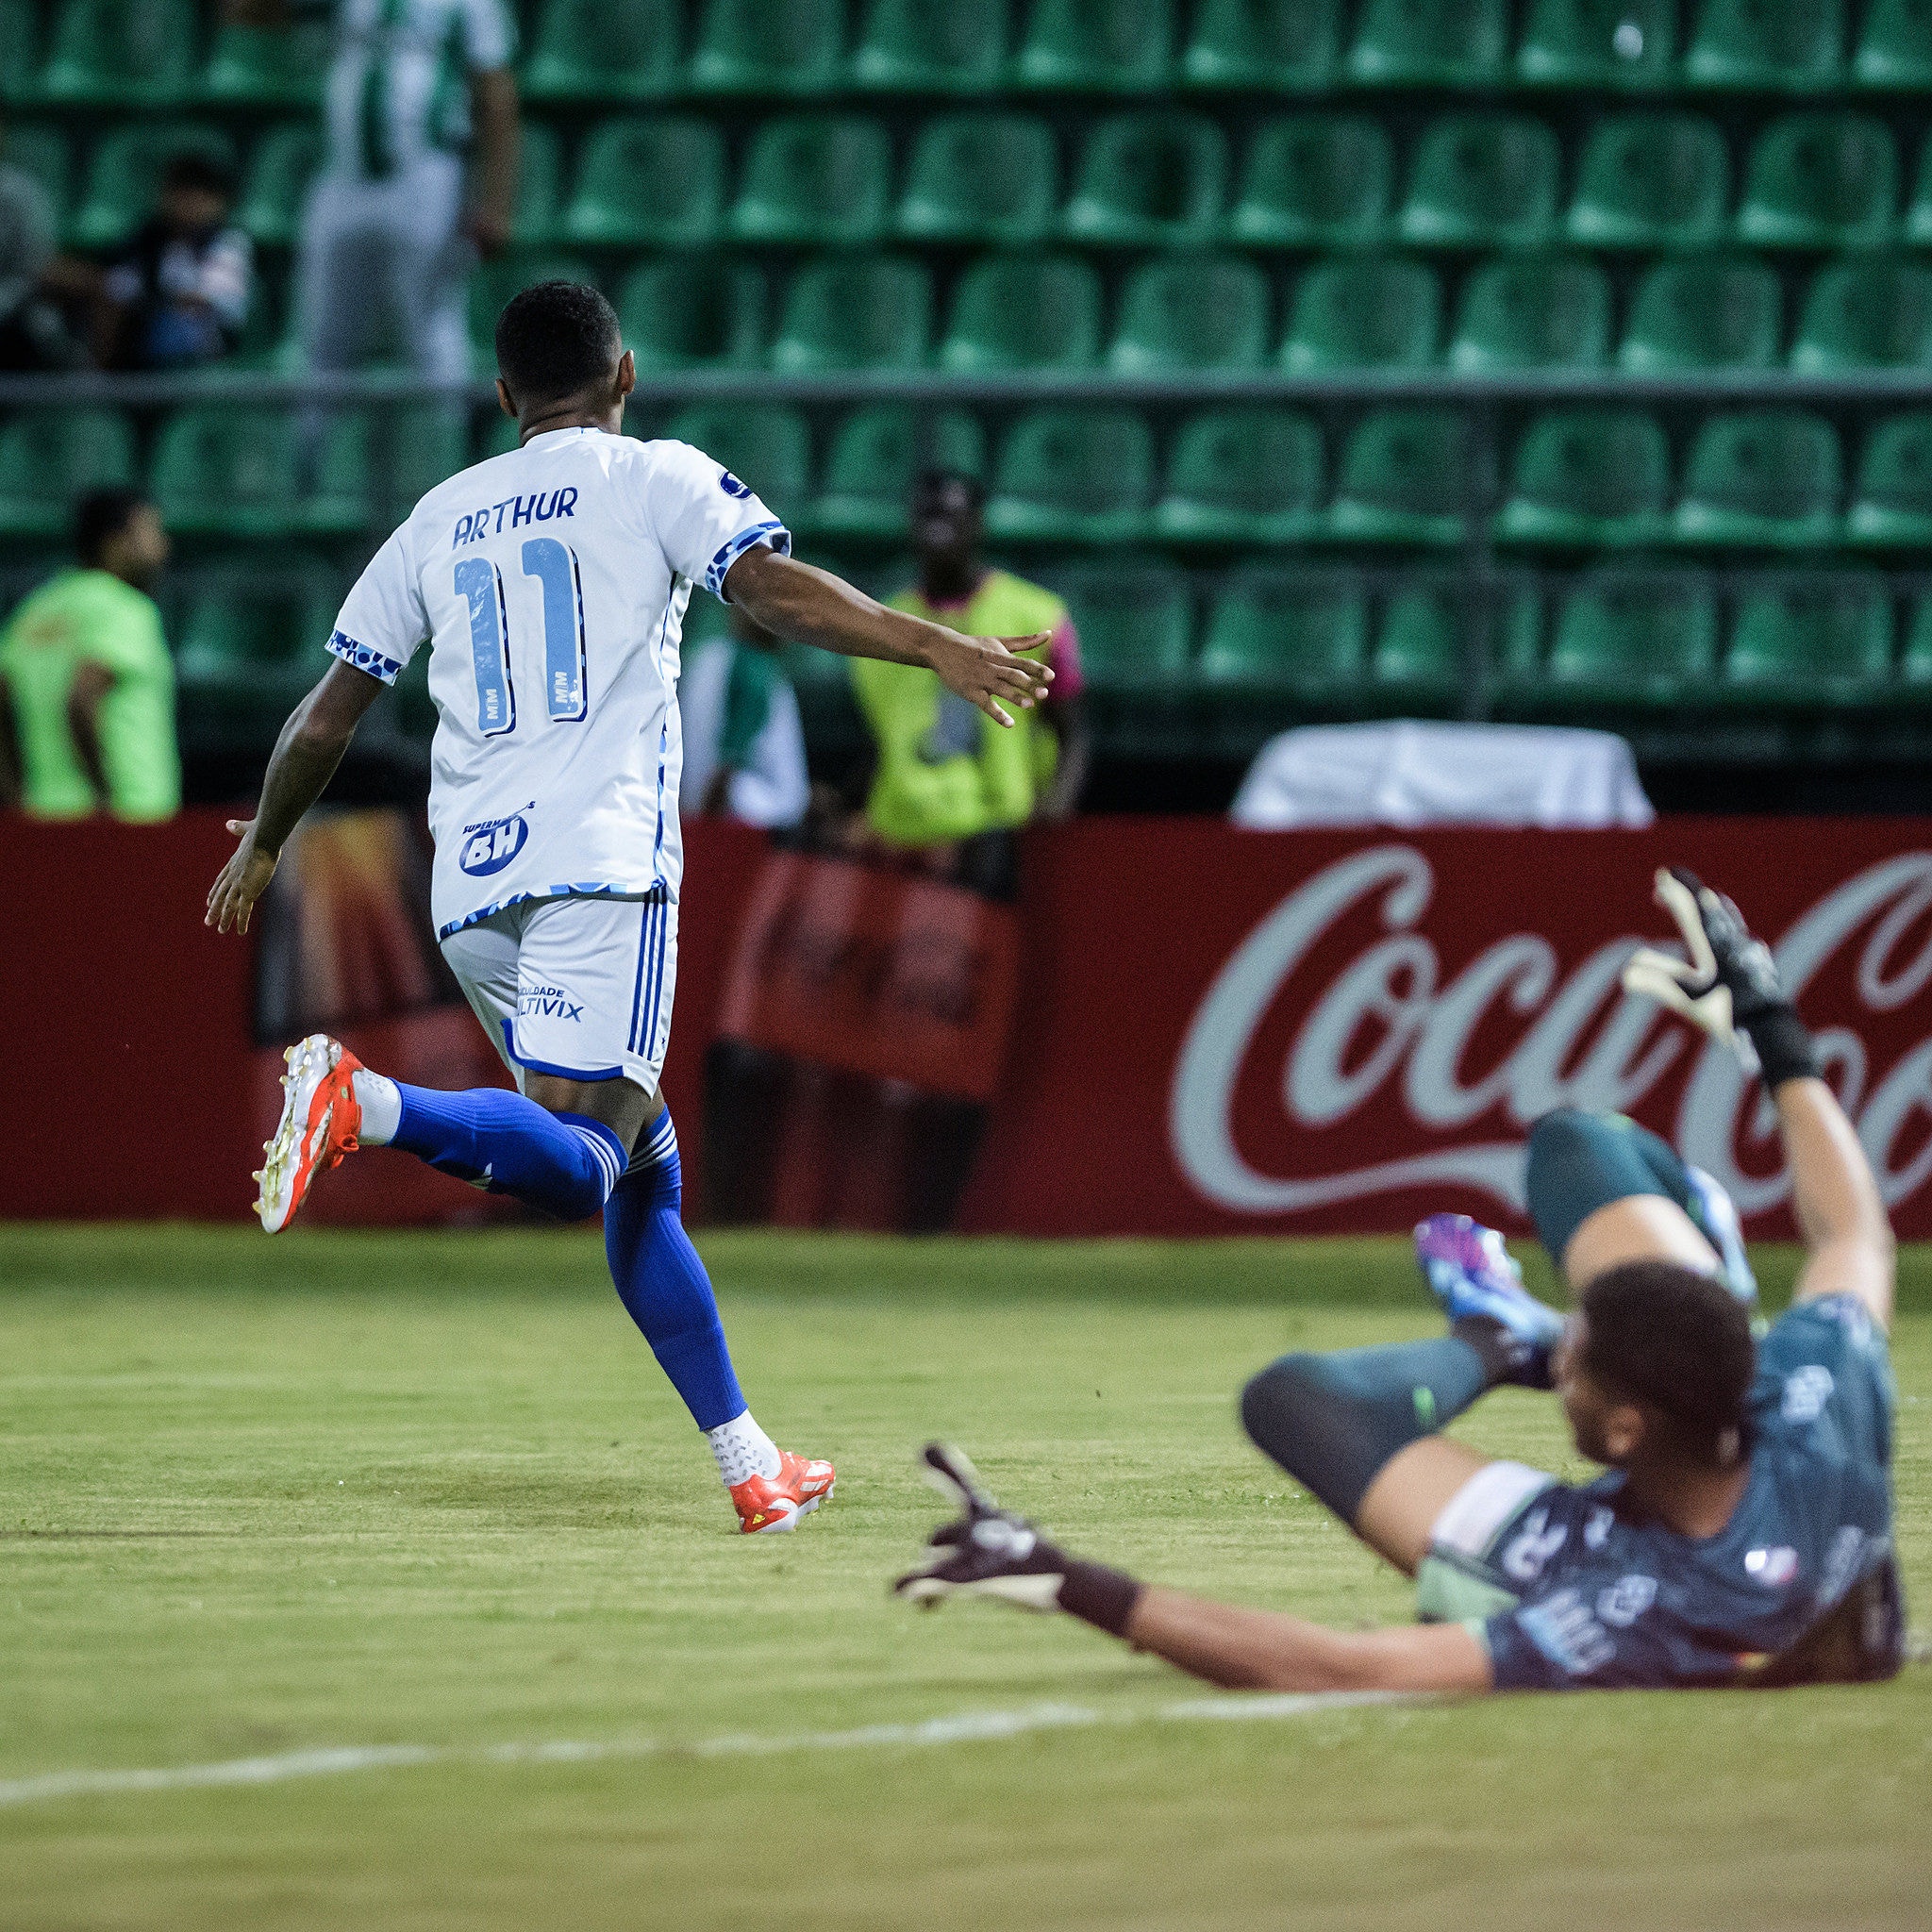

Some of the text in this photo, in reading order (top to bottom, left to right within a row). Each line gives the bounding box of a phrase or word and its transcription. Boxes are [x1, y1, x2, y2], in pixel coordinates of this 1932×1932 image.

[453, 486, 578, 550] ARTHUR
[454, 537, 588, 738] 11
[464, 819, 521, 868] BH
[518, 997, 584, 1024] LTIVIX
